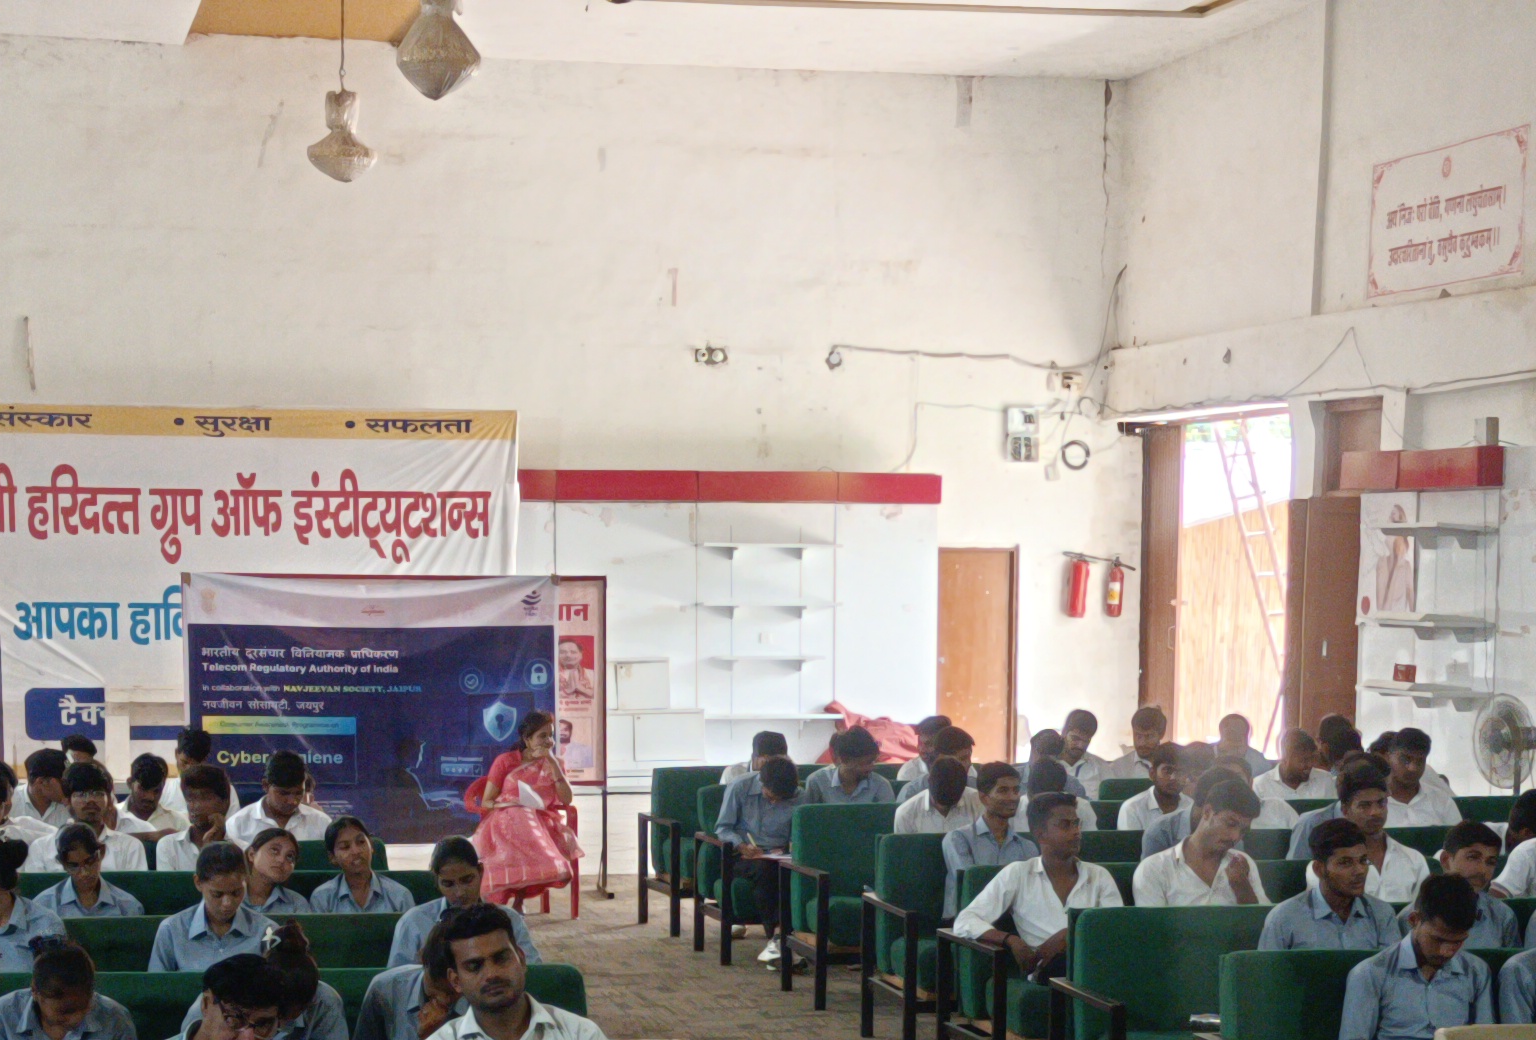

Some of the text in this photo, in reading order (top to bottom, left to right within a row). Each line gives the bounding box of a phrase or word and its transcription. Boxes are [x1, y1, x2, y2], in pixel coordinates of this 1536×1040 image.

[194, 416, 271, 437] सुरक्षा
[366, 419, 472, 433] सफलता
[26, 463, 142, 541] हरिदत्त
[149, 488, 203, 565] ग्रुप
[211, 472, 283, 539] ऑफ
[13, 602, 120, 641] आपका
[201, 646, 400, 661] भारतीय दूरसंचार विनियामक प्राधिकरण
[202, 663, 399, 675] Telecom Regulatory Authority of India
[284, 685, 341, 693] NAVJEEVAN
[387, 685, 422, 693] JAIPUR
[202, 698, 243, 710] नवजीवन
[296, 701, 325, 713] जयपुर
[217, 750, 269, 767] Cyber
